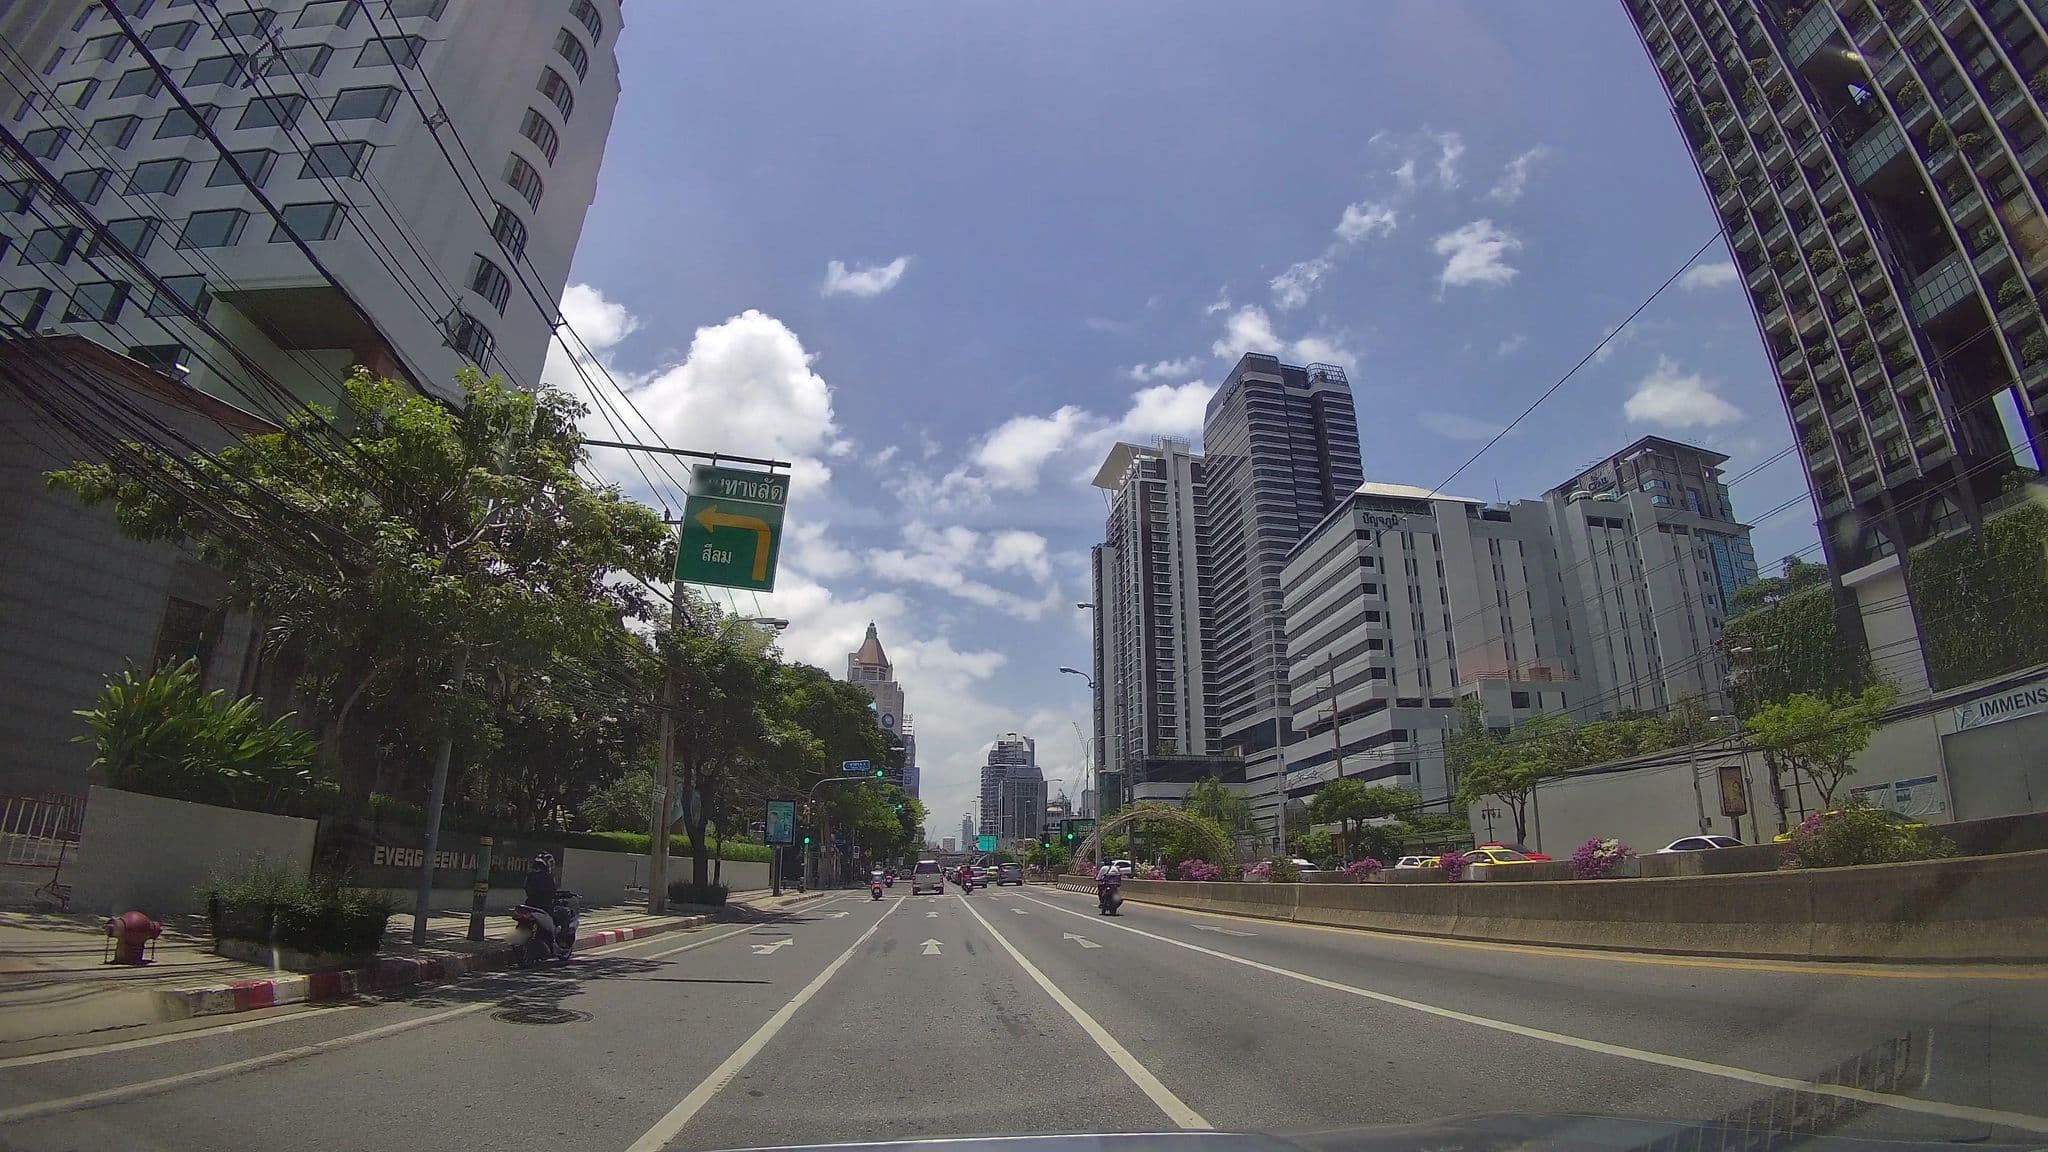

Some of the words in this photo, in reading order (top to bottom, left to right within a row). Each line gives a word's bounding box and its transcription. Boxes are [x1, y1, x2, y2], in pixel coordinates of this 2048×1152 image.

[725, 477, 783, 501] ทางลัด
[702, 543, 732, 564] สีลม
[1979, 688, 2048, 717] IMMENS
[373, 845, 459, 869] EVERGEEN
